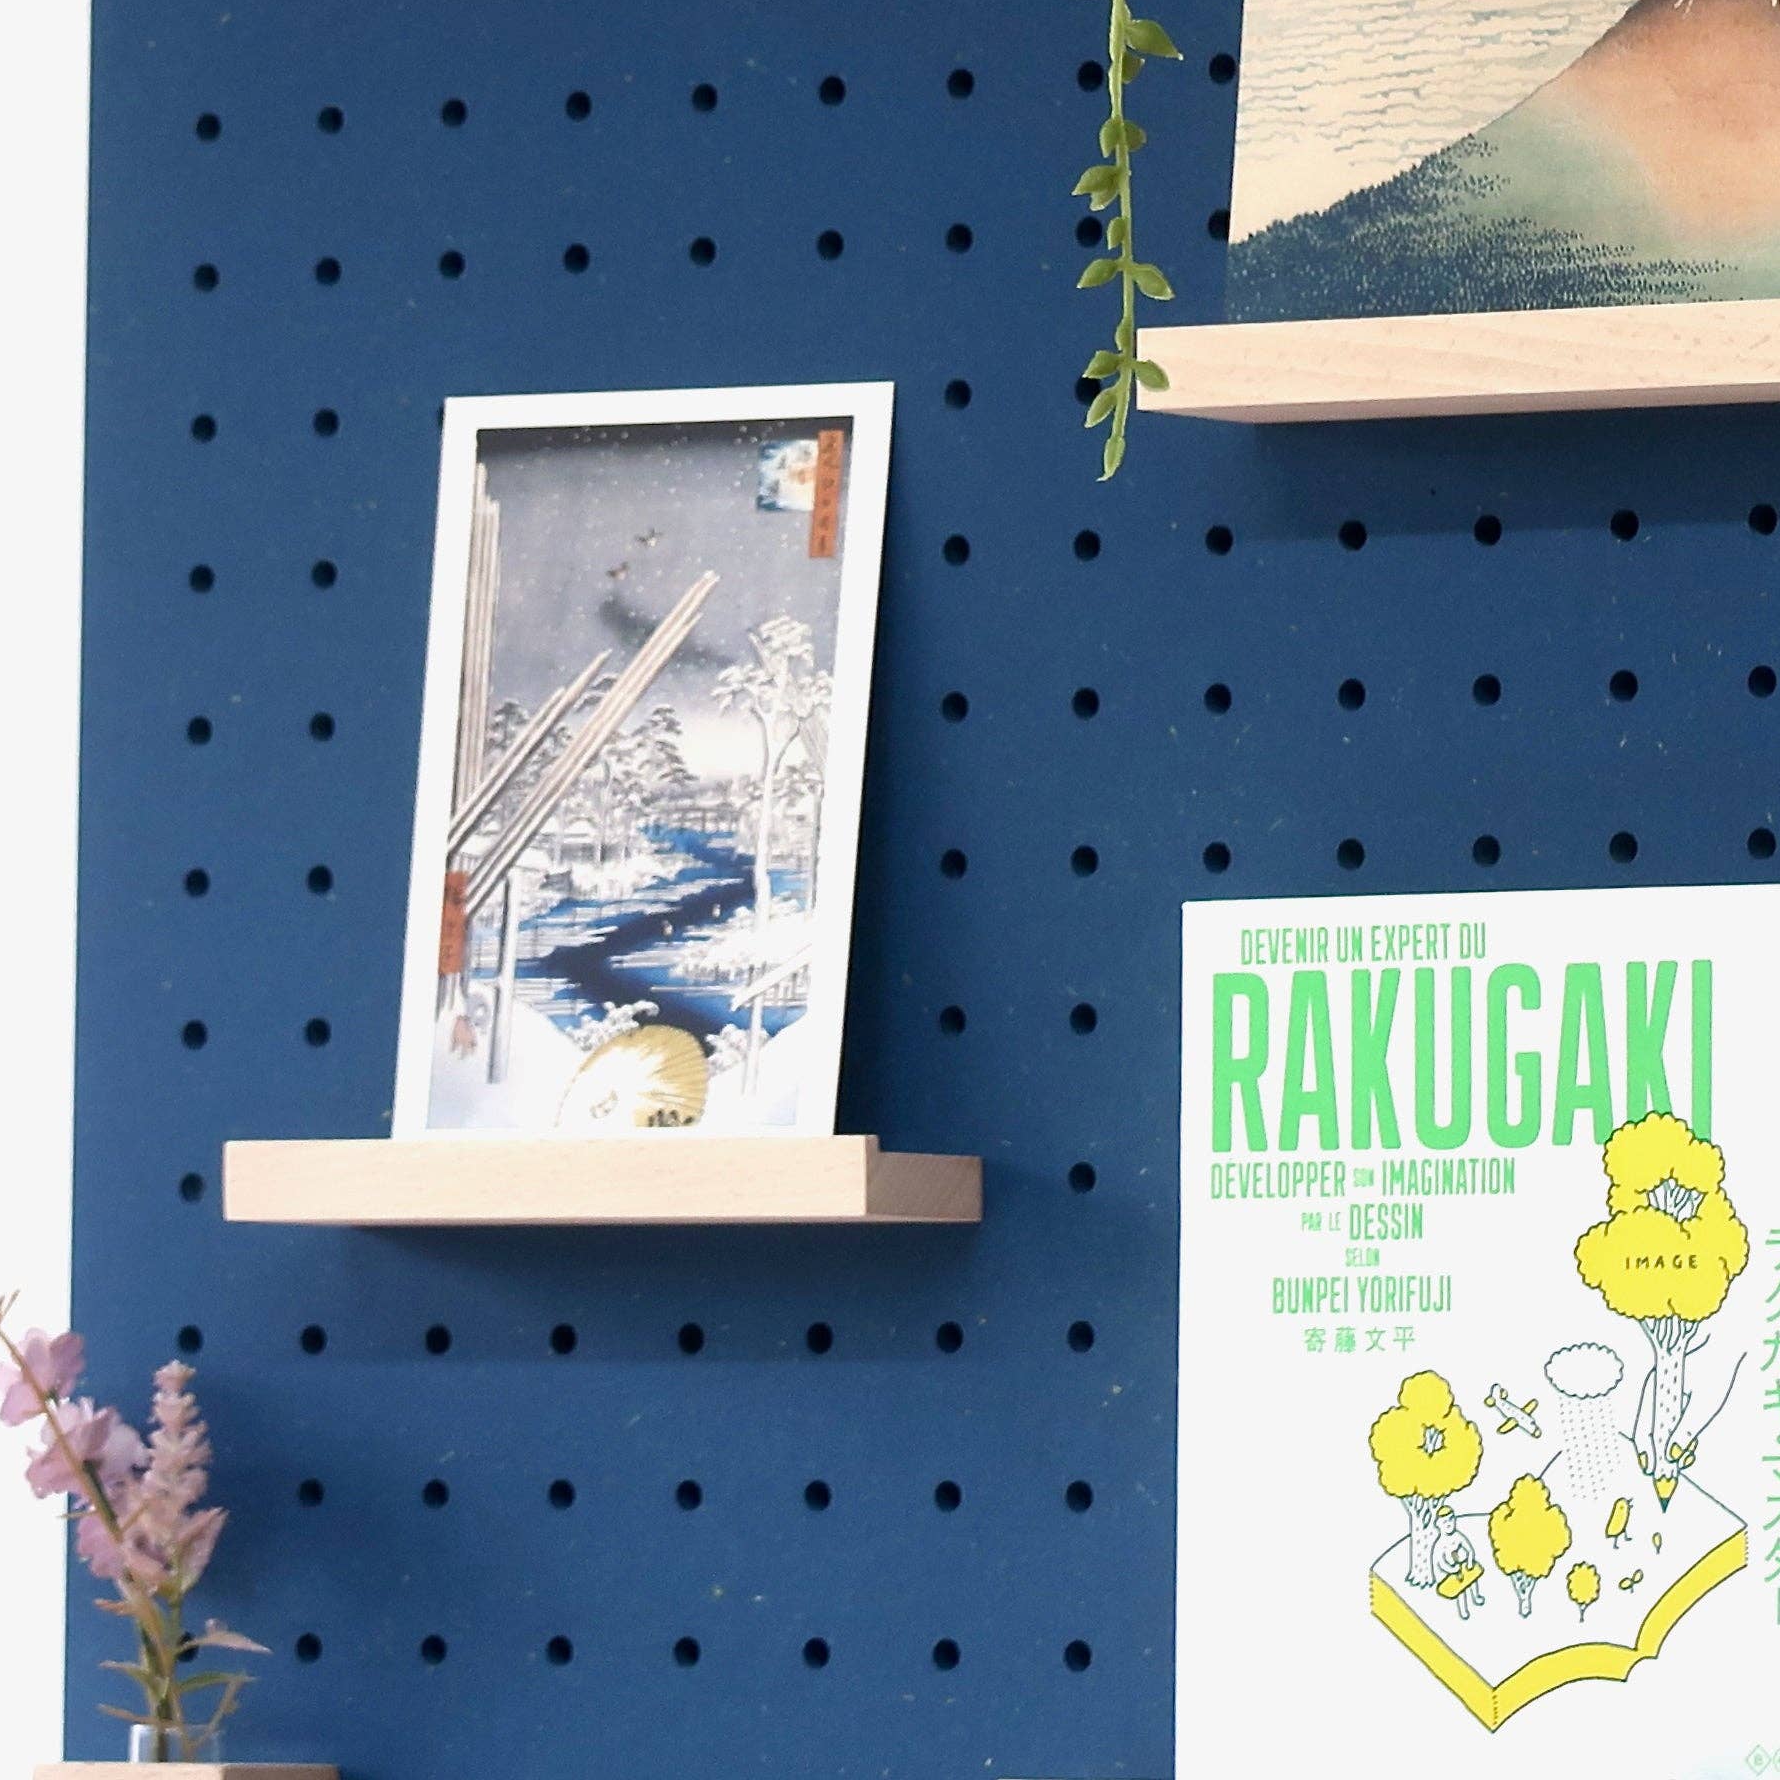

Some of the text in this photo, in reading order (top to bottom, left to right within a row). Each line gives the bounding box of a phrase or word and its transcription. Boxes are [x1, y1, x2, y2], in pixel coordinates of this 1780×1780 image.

[1240, 921, 1486, 966] DEVENIR UN EXPERT DU
[1211, 959, 1713, 1153] RAKUGAKI
[1382, 1156, 1516, 1197] IMAGINATION
[1301, 1202, 1424, 1241] PAR LE DESSIN
[1345, 1247, 1381, 1268] SELON
[1625, 1254, 1699, 1271] IMAGE
[1272, 1274, 1452, 1314] BUNPEI YORIFUJI
[1303, 1326, 1416, 1353] 寄藤文平
